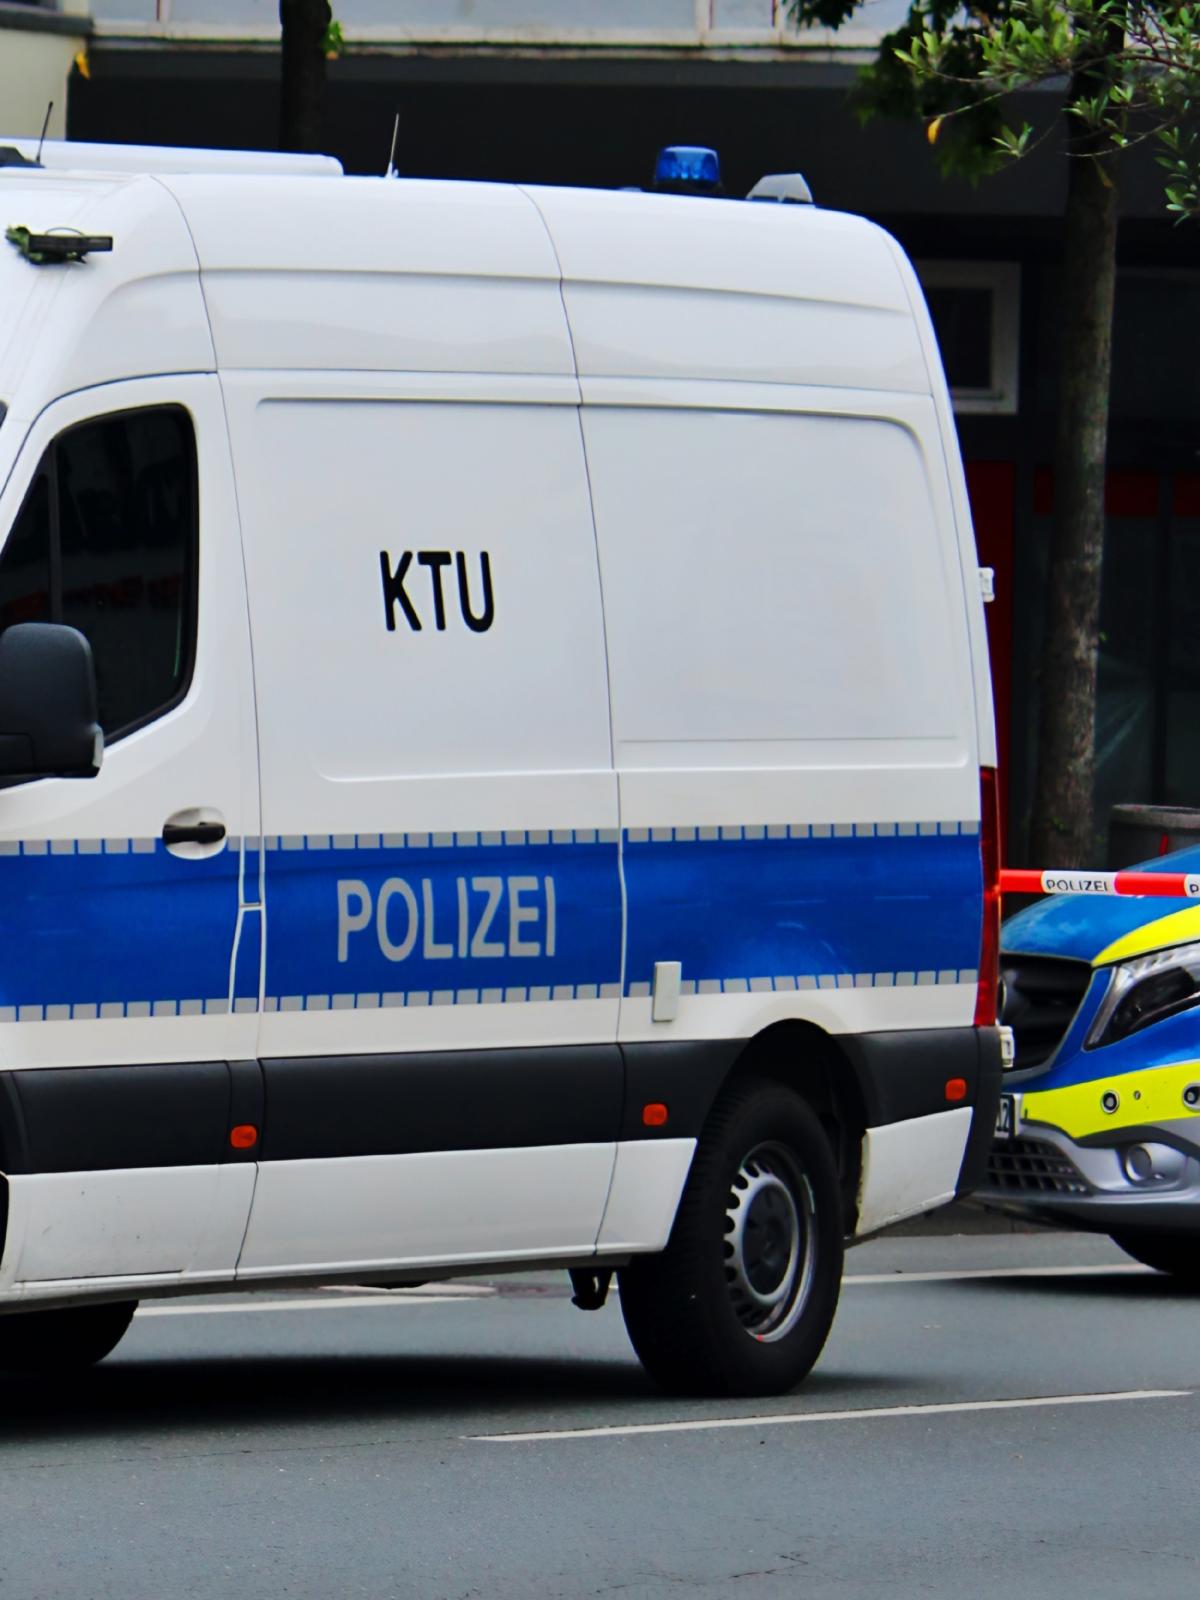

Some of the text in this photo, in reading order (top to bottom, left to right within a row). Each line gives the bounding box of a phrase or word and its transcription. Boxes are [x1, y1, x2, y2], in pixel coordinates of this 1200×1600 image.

[379, 550, 495, 633] KTU
[337, 876, 555, 963] POLIZEI
[1046, 879, 1108, 892] POLIZEI
